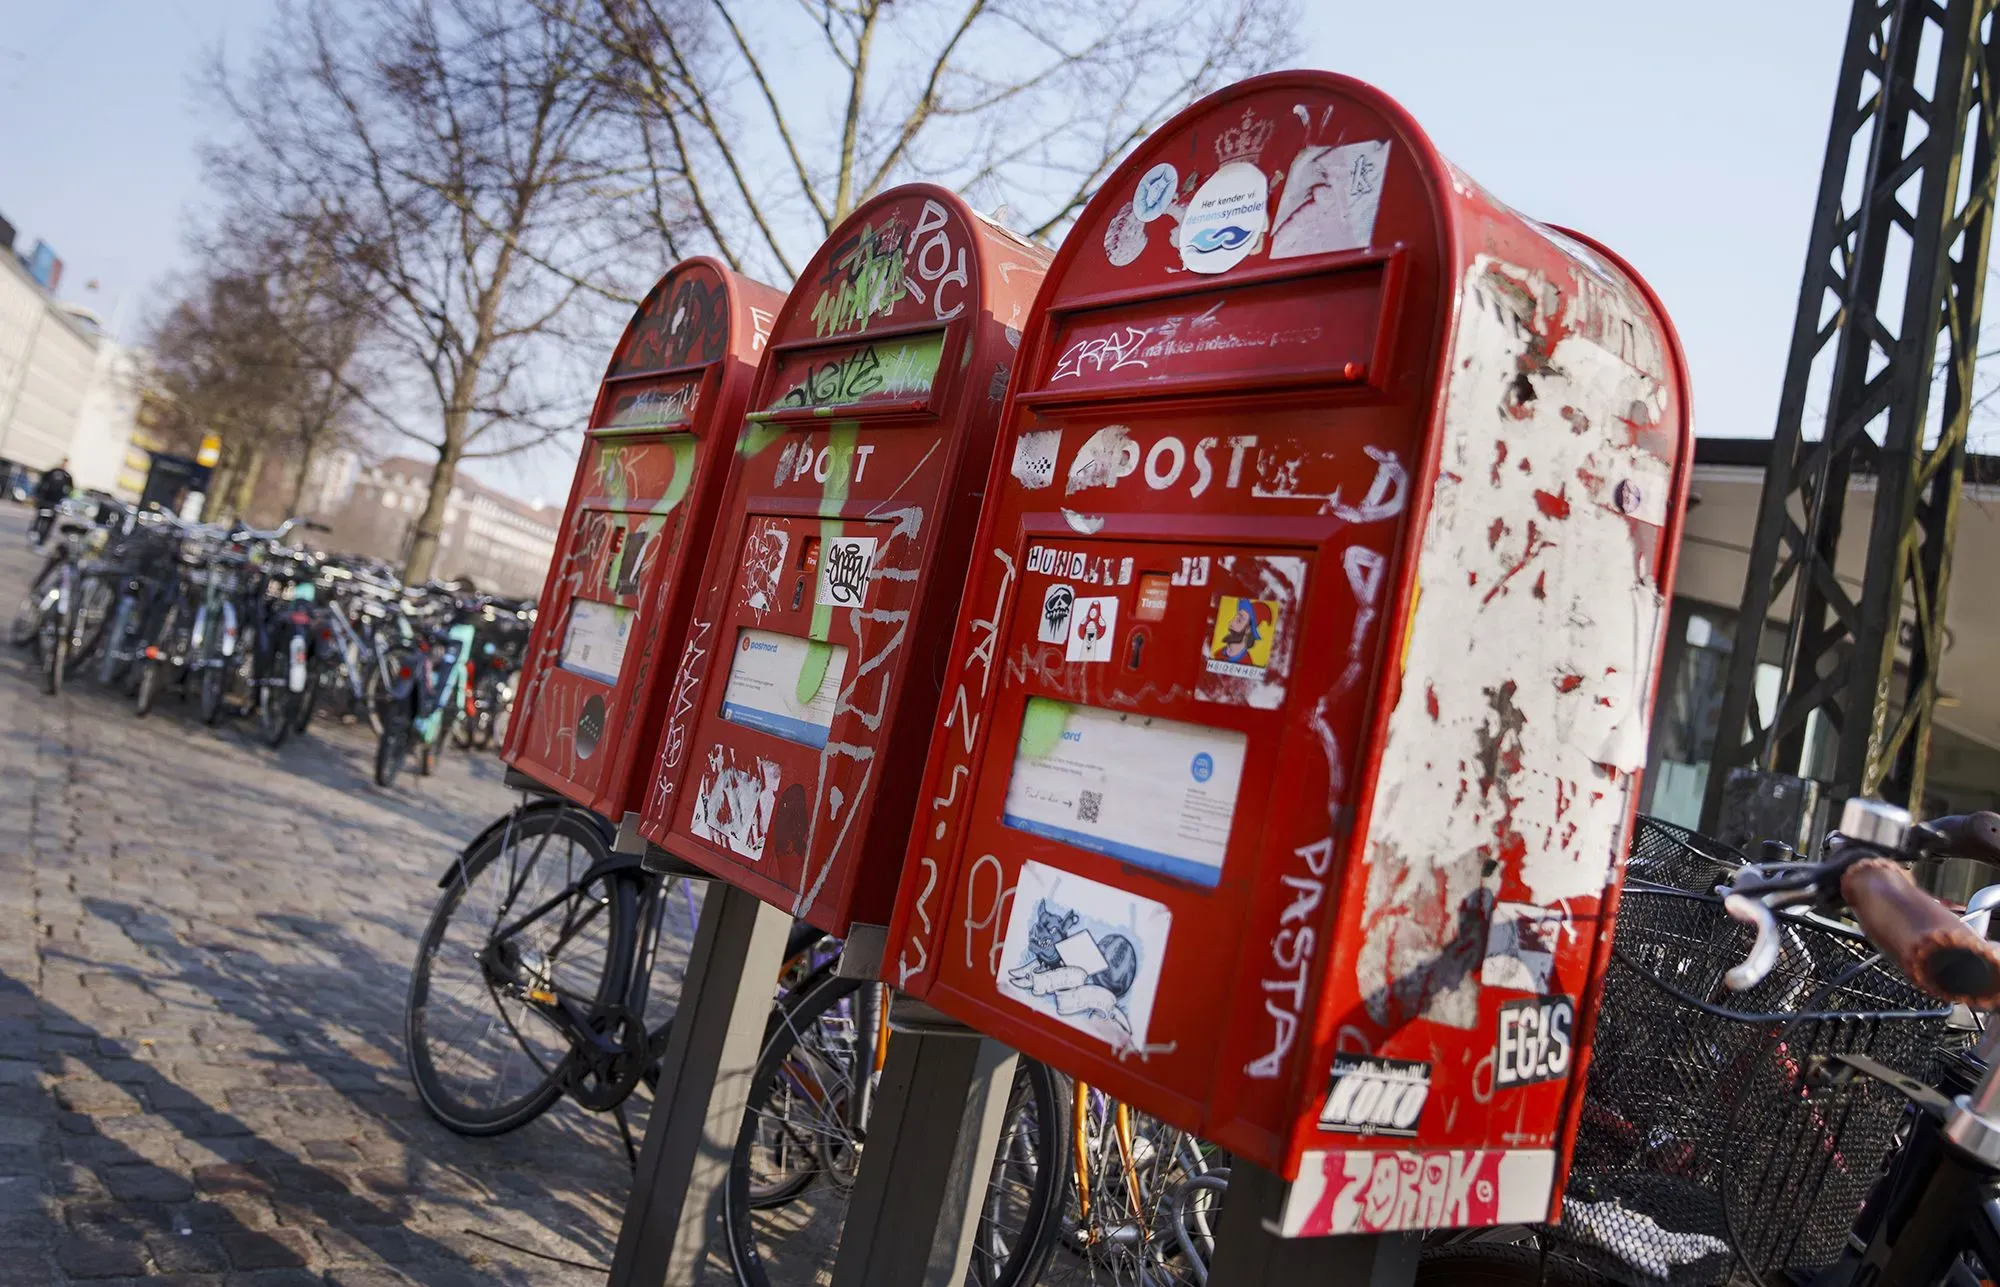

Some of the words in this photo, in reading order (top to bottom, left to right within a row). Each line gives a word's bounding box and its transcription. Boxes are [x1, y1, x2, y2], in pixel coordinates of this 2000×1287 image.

[1201, 200, 1216, 209] Her
[1218, 192, 1246, 206] kender
[792, 444, 876, 488] POST
[1107, 435, 1257, 498] POST
[750, 641, 778, 653] postnord
[1244, 836, 1334, 1079] PASTA
